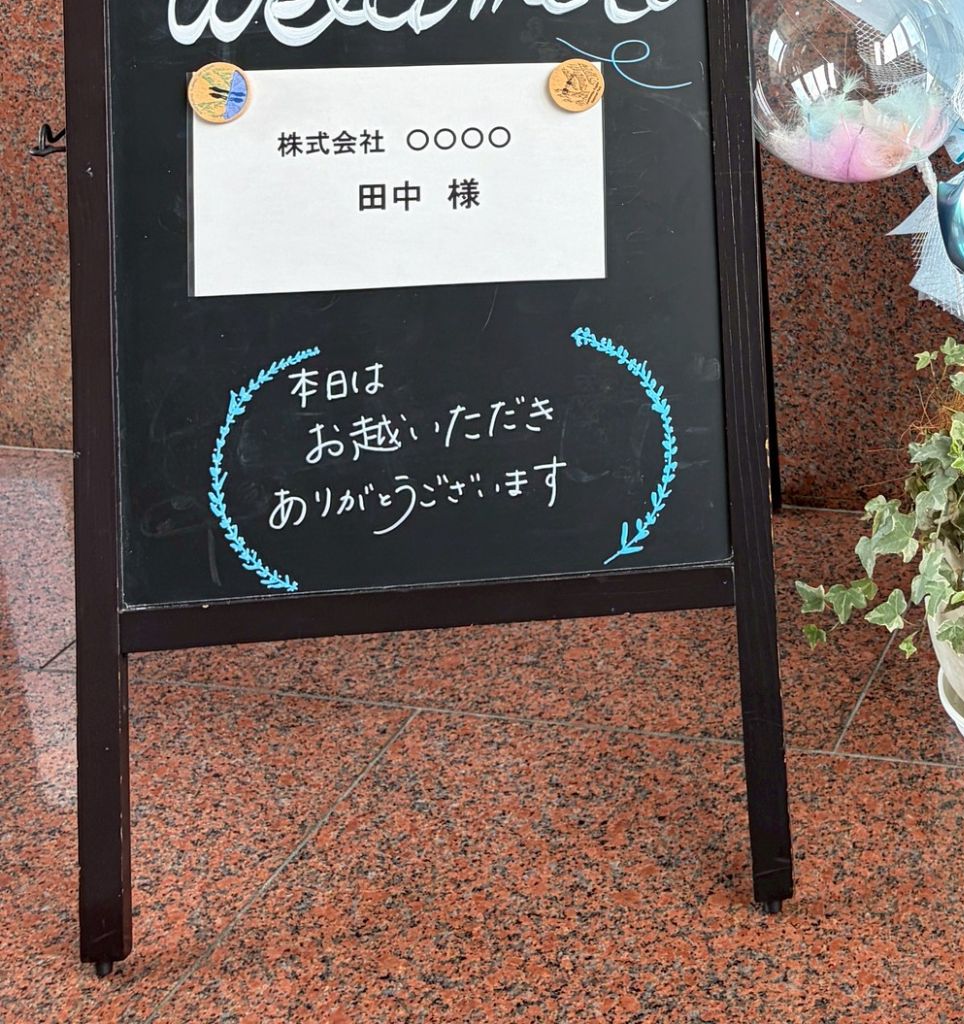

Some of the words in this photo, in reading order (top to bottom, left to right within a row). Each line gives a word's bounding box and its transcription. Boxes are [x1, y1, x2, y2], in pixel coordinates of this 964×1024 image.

[277, 129, 385, 157] 株式会社
[358, 180, 421, 212] 田中
[447, 178, 480, 210] 様
[288, 363, 384, 408] 本日は
[269, 456, 567, 535] ありがとうございます
